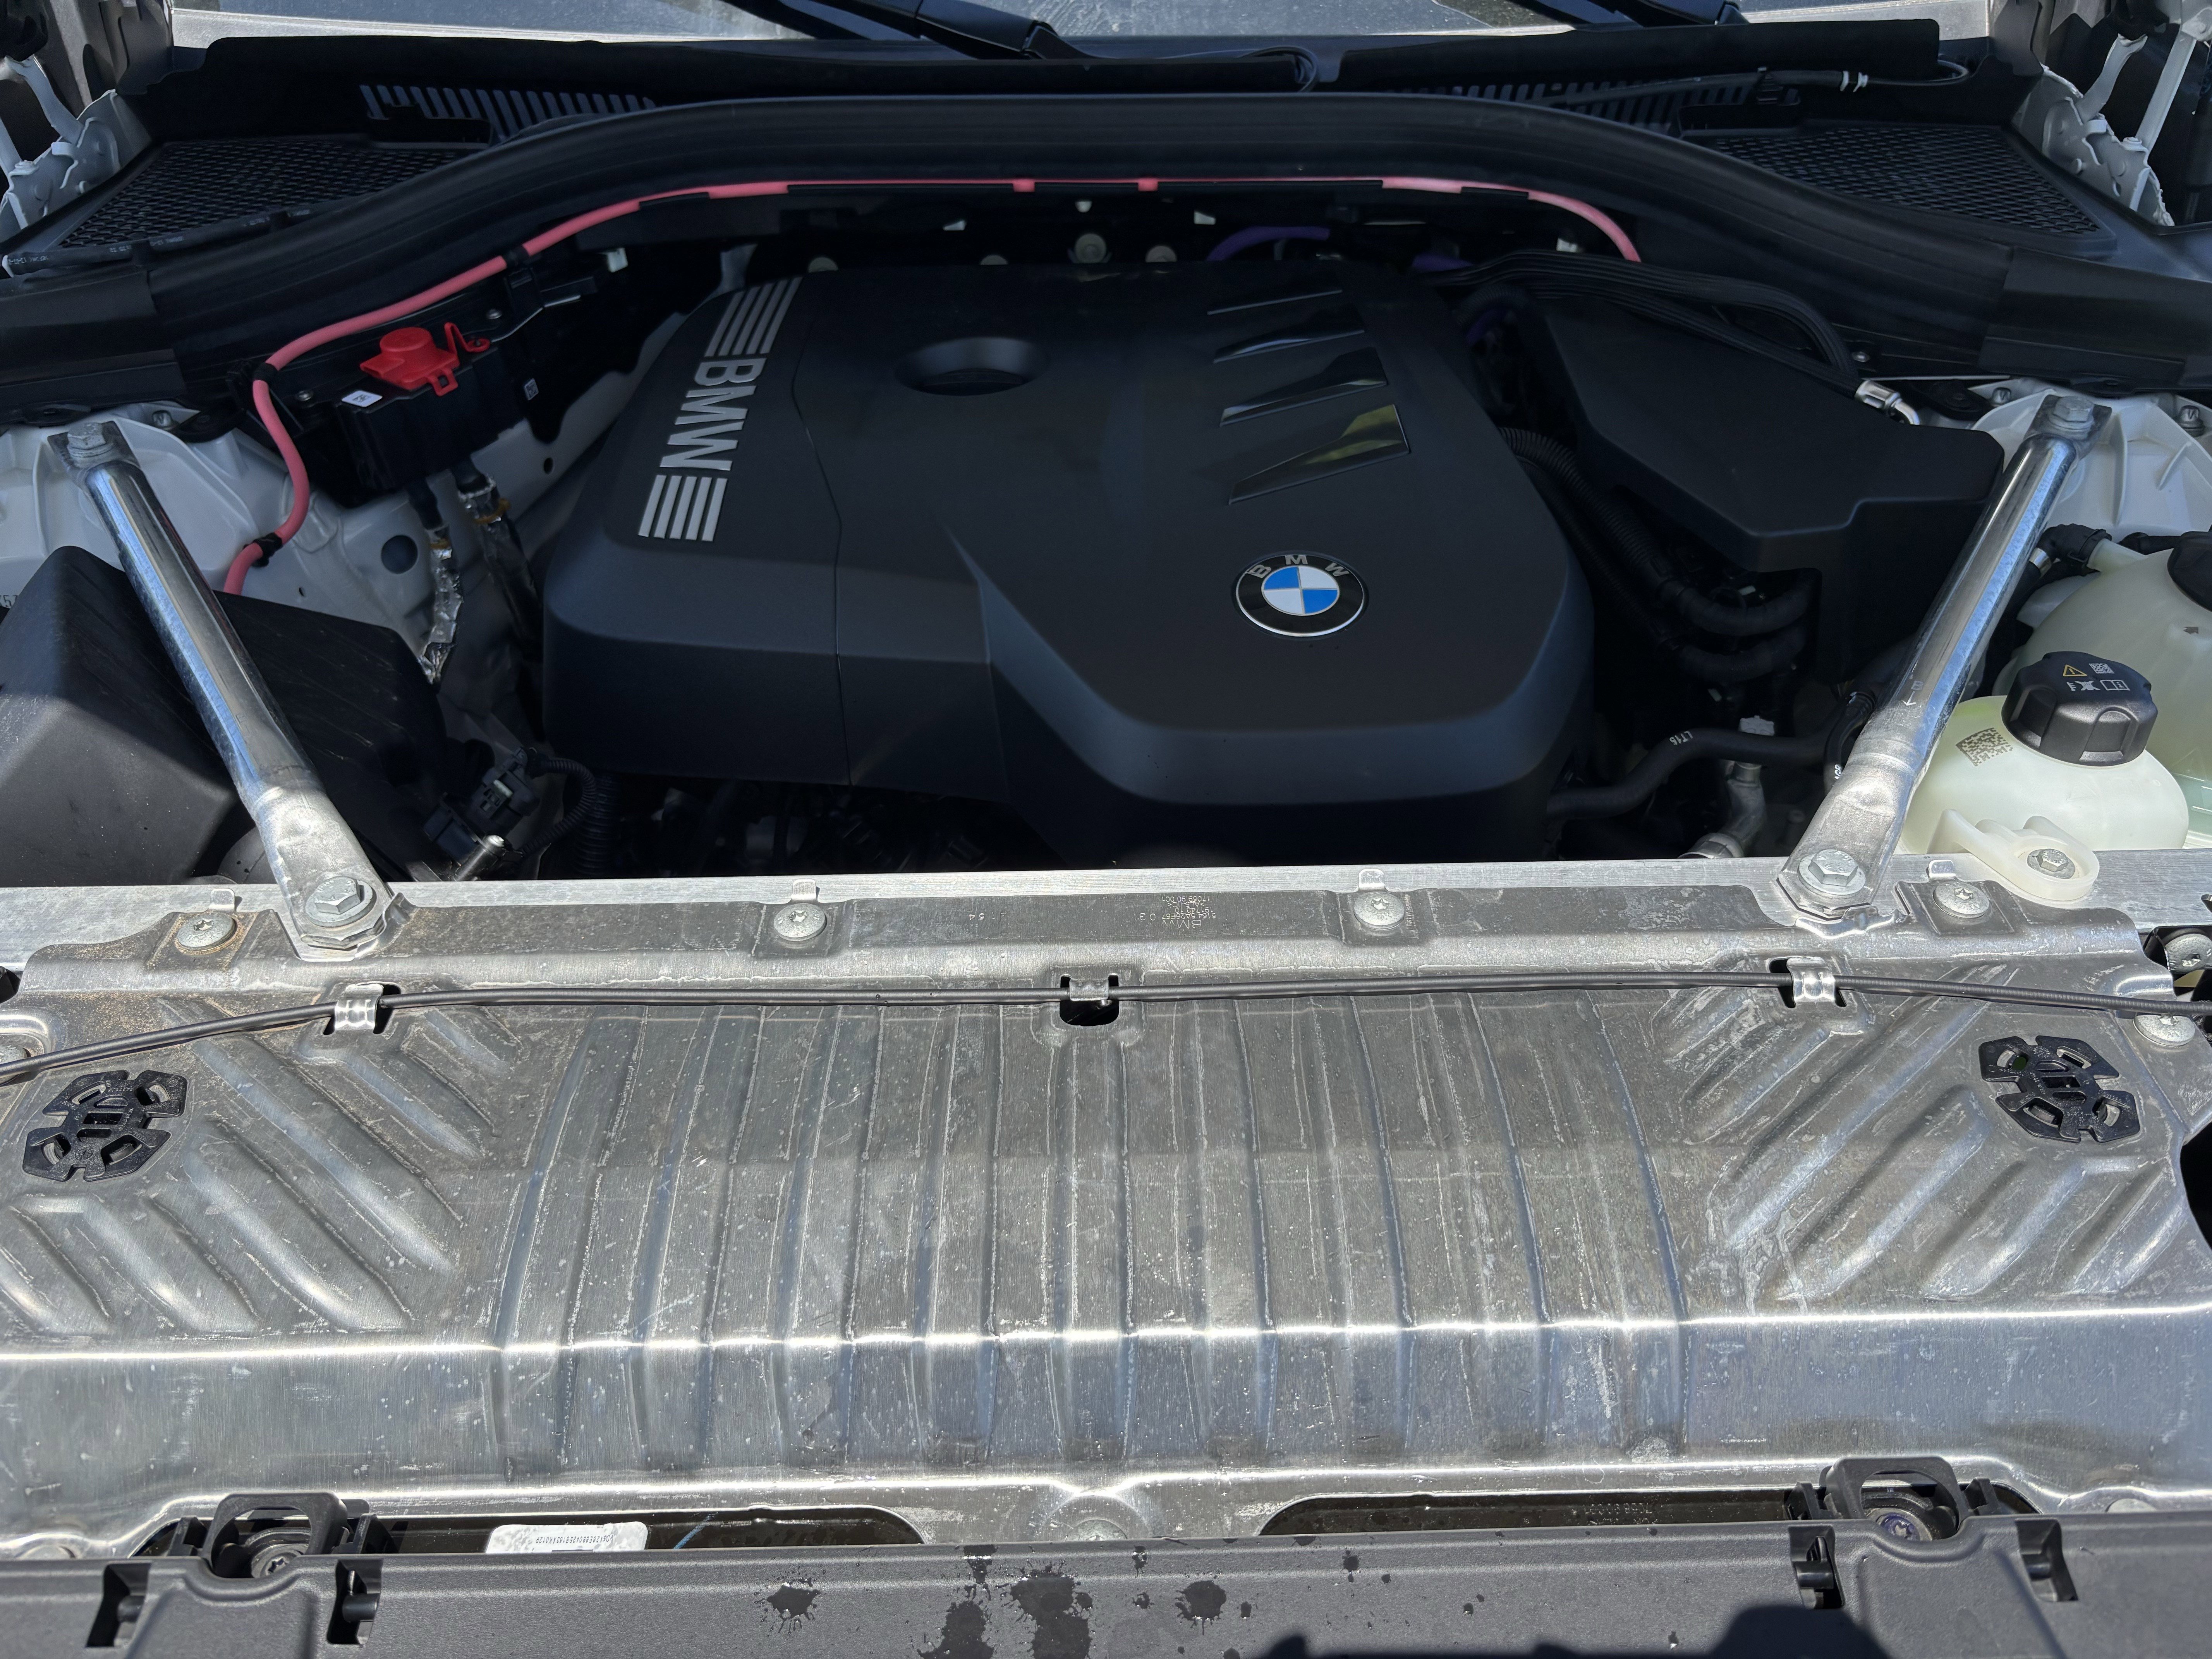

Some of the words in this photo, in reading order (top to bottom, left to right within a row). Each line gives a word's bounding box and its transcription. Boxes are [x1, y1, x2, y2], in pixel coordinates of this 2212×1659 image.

[659, 357, 768, 471] BMW
[1246, 554, 1350, 579] BMW
[1162, 919, 1202, 929] BMW
